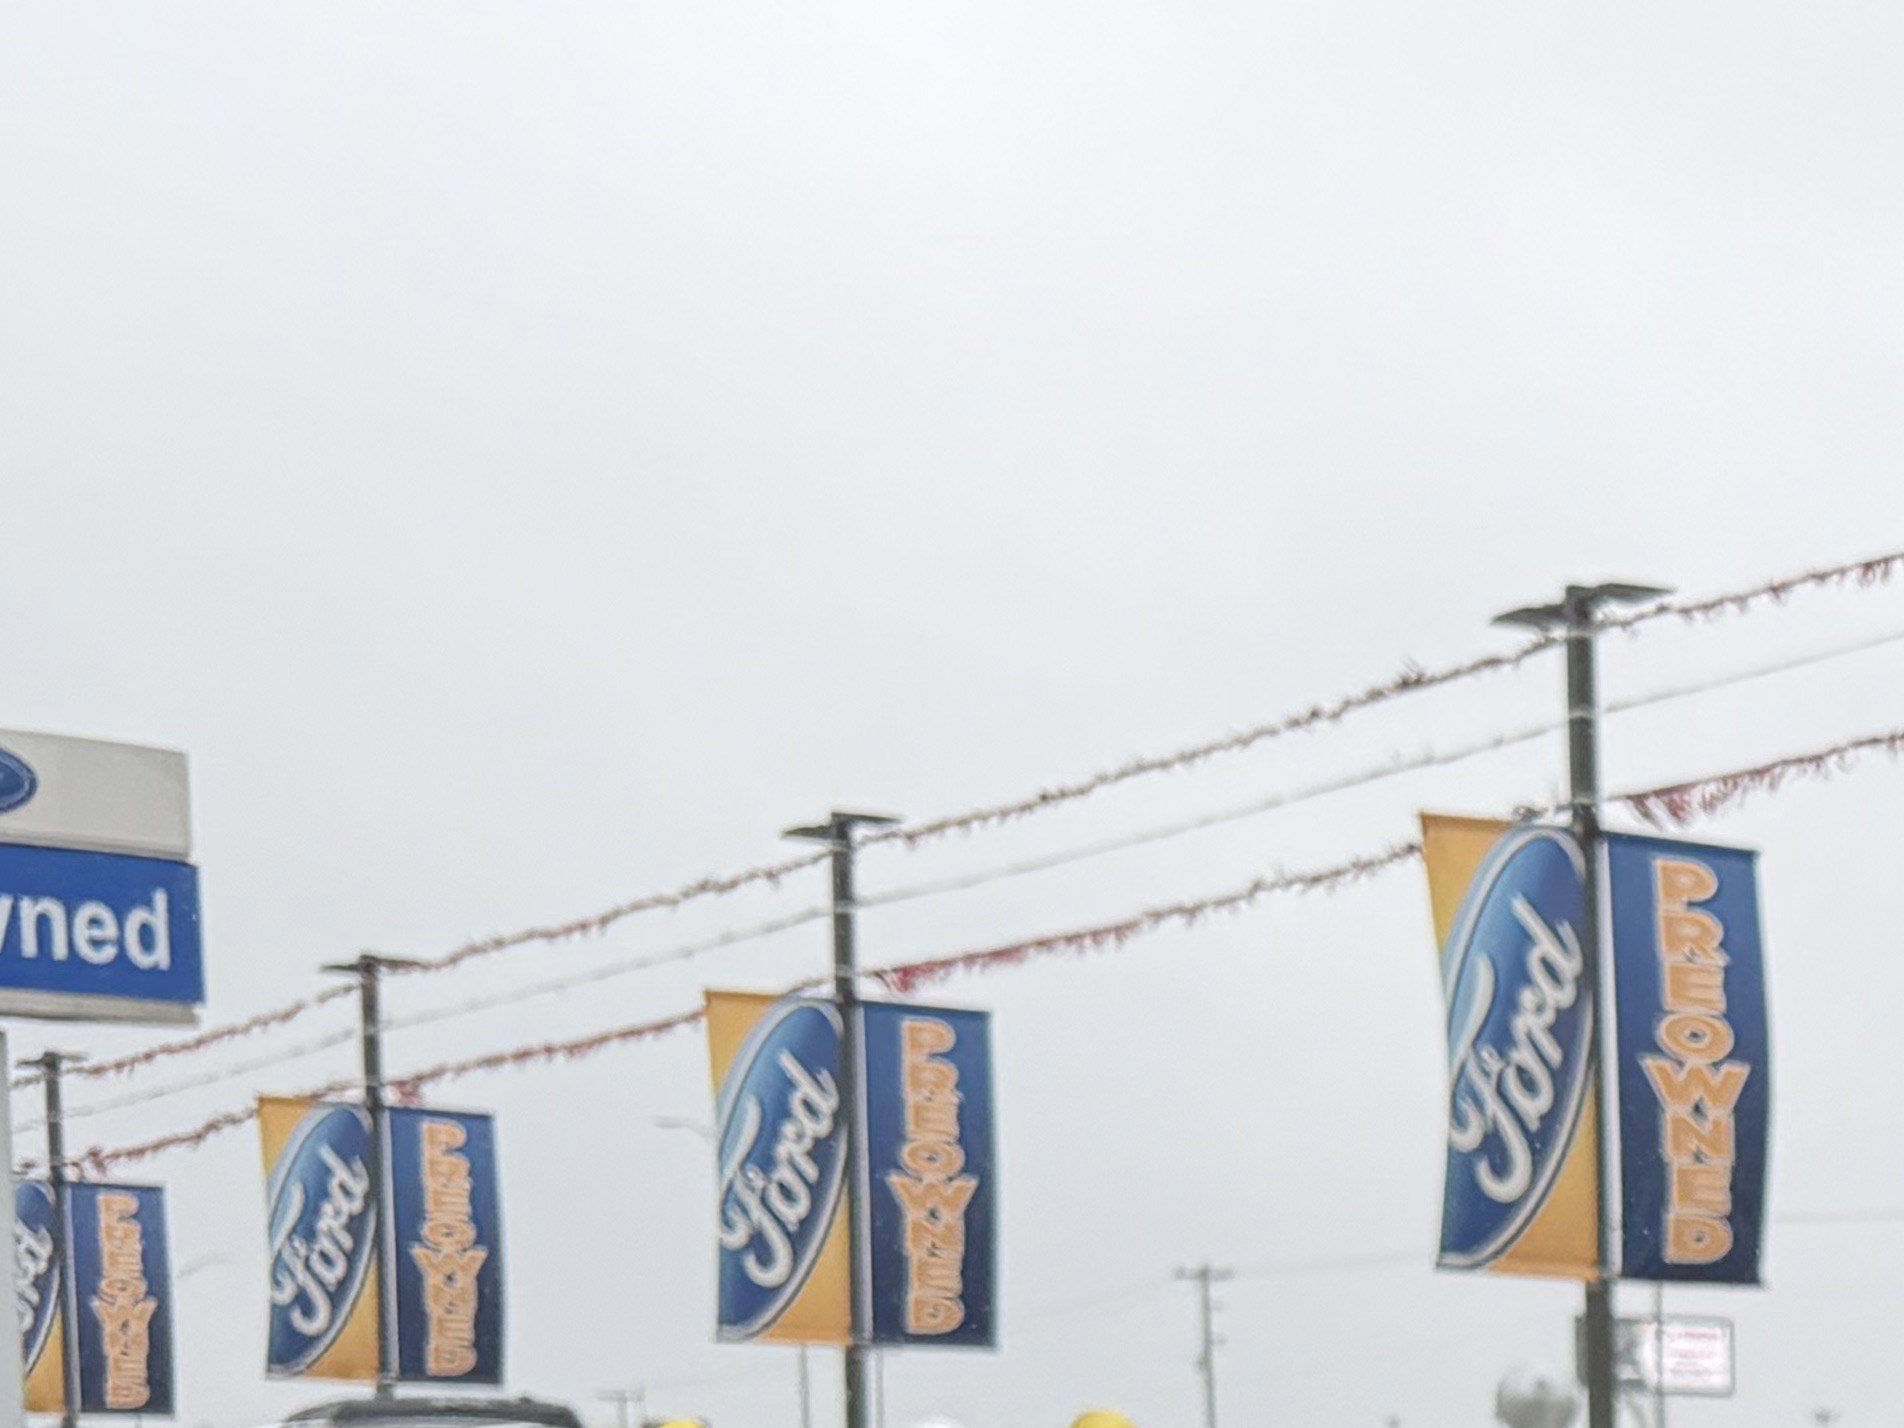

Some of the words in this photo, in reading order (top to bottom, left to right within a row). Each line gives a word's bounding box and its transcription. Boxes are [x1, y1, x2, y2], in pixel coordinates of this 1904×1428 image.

[718, 1049, 839, 1288] Ford
[888, 1016, 979, 1335] PREOWNED
[1450, 892, 1584, 1203] Ford
[1640, 857, 1751, 1265] PREOWNED
[271, 1145, 370, 1335] Ford
